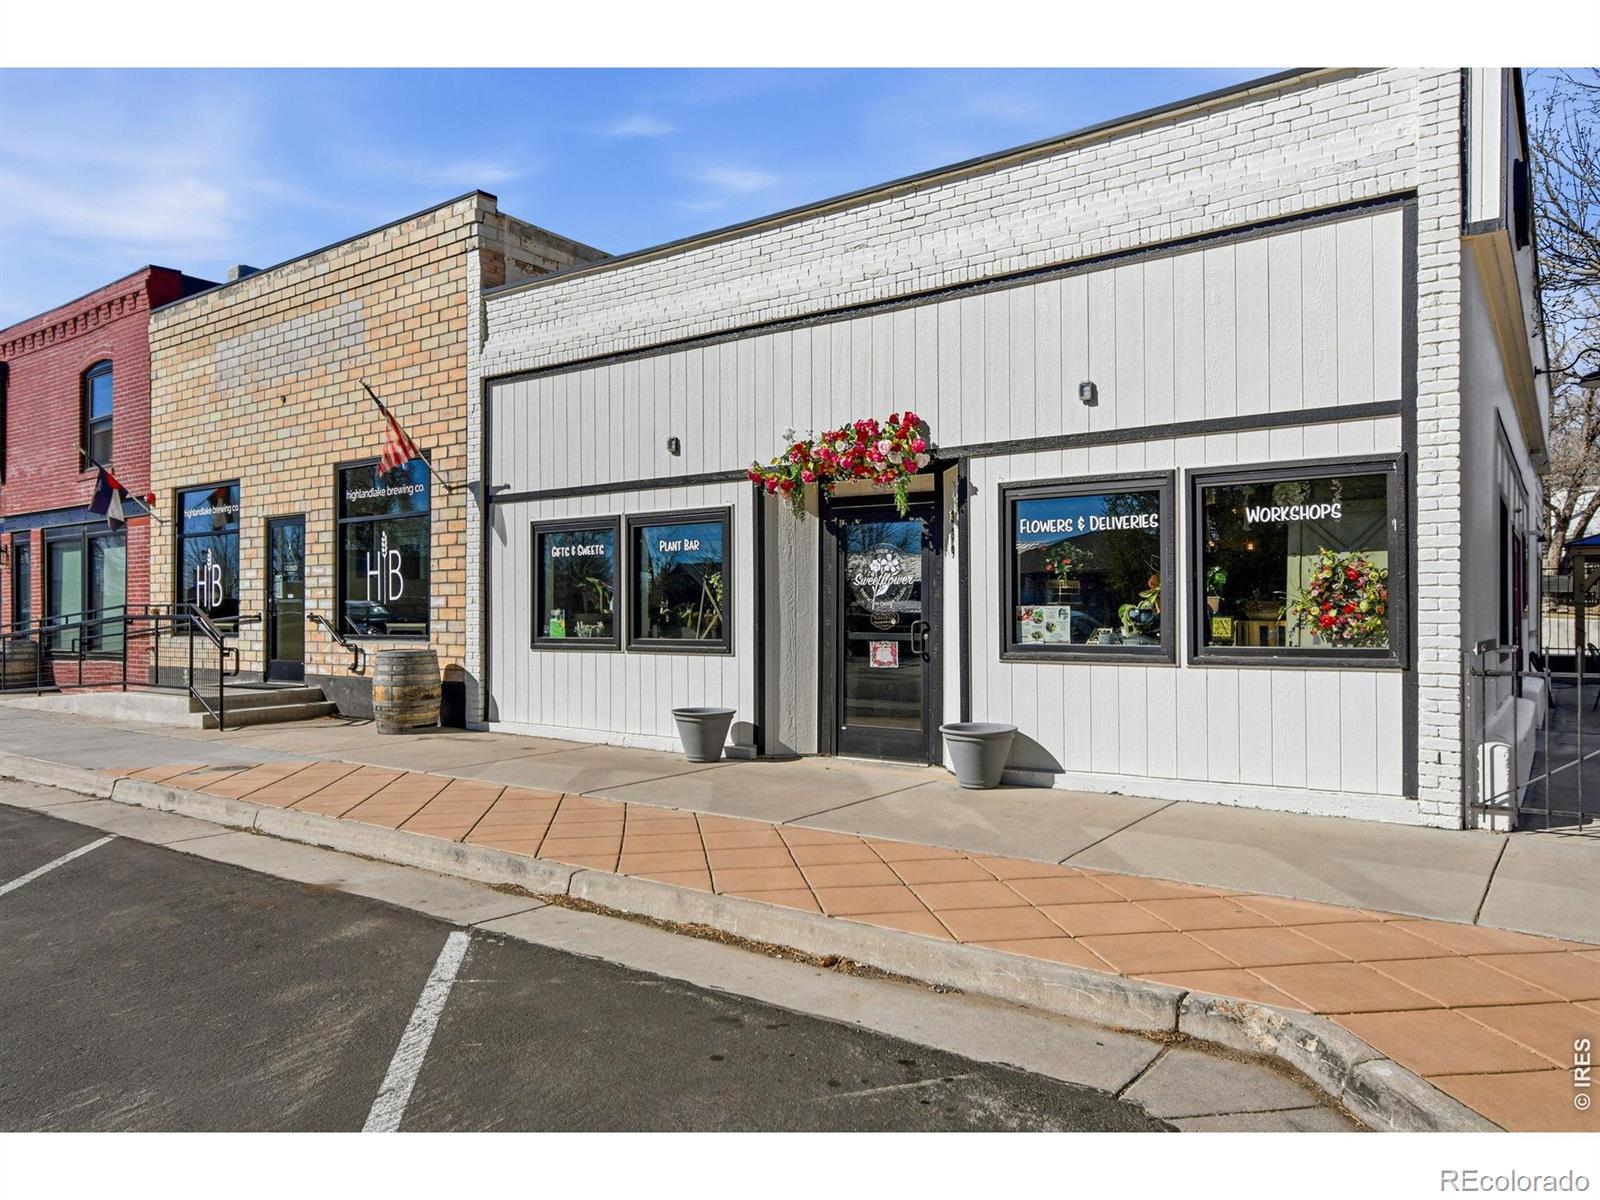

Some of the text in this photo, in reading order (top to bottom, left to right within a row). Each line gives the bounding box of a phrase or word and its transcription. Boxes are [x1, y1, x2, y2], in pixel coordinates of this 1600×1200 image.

[345, 488, 386, 501] highlandlake
[387, 484, 414, 496] brewing
[184, 507, 213, 519] highlandlake
[213, 503, 232, 515] brewing
[1246, 502, 1342, 523] WORKSHOPS
[1020, 513, 1159, 533] FLOWERS & DELIVERIES
[552, 544, 604, 557] GIFTS & SWEETS
[659, 538, 700, 552] PLANT BAR
